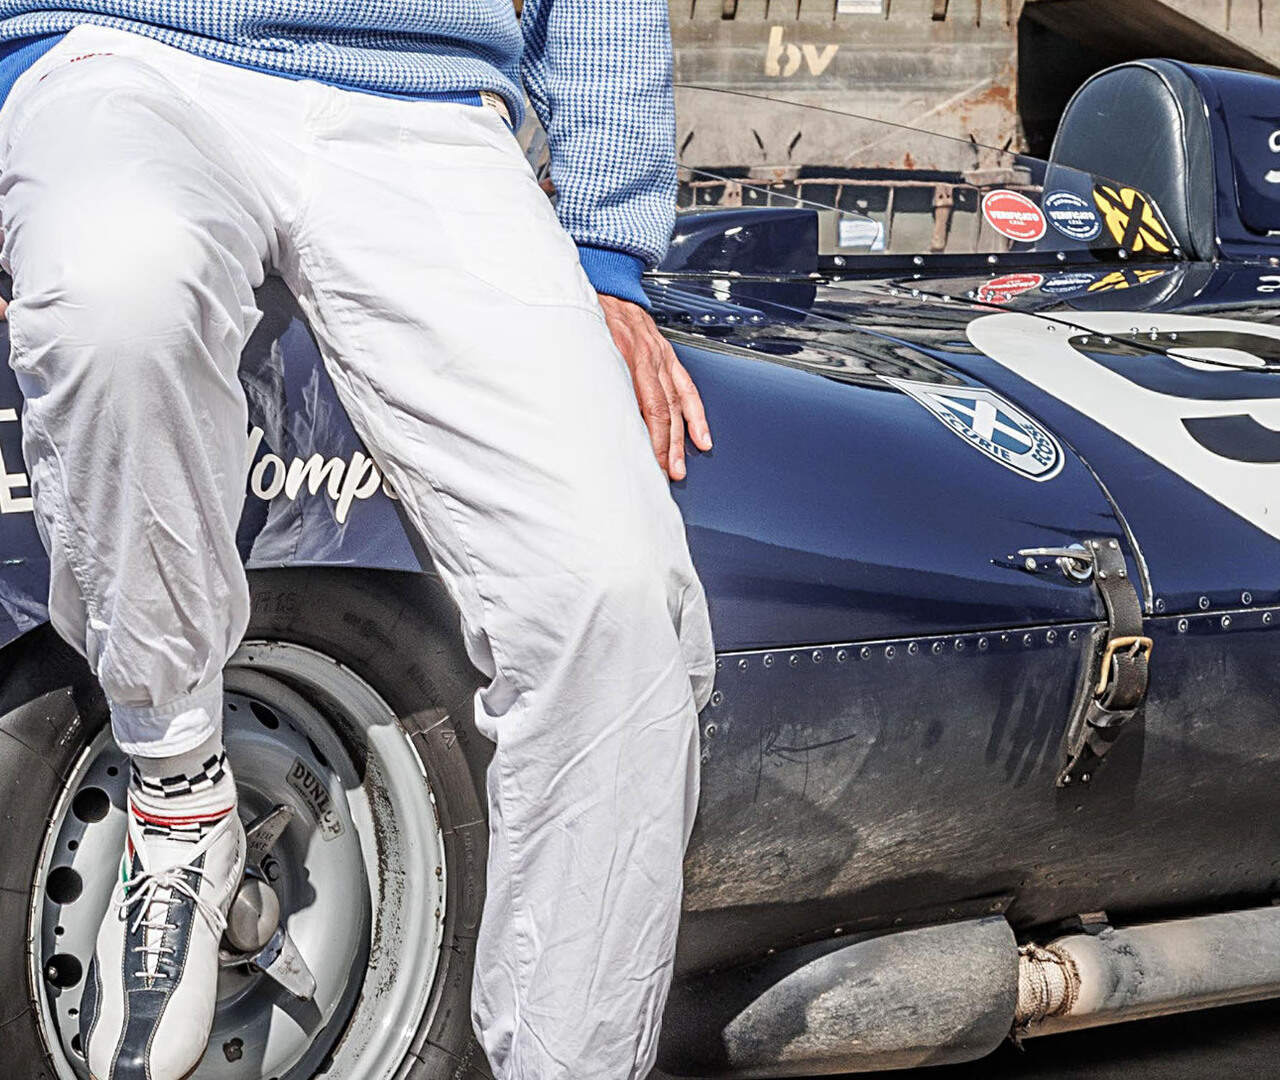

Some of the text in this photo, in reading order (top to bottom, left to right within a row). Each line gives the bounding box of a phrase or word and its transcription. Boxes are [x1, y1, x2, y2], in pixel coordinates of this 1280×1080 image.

[764, 26, 840, 77] bv
[939, 410, 1013, 462] ECURIE
[1019, 422, 1054, 467] ECOSSE
[292, 762, 342, 835] DUNLOP
